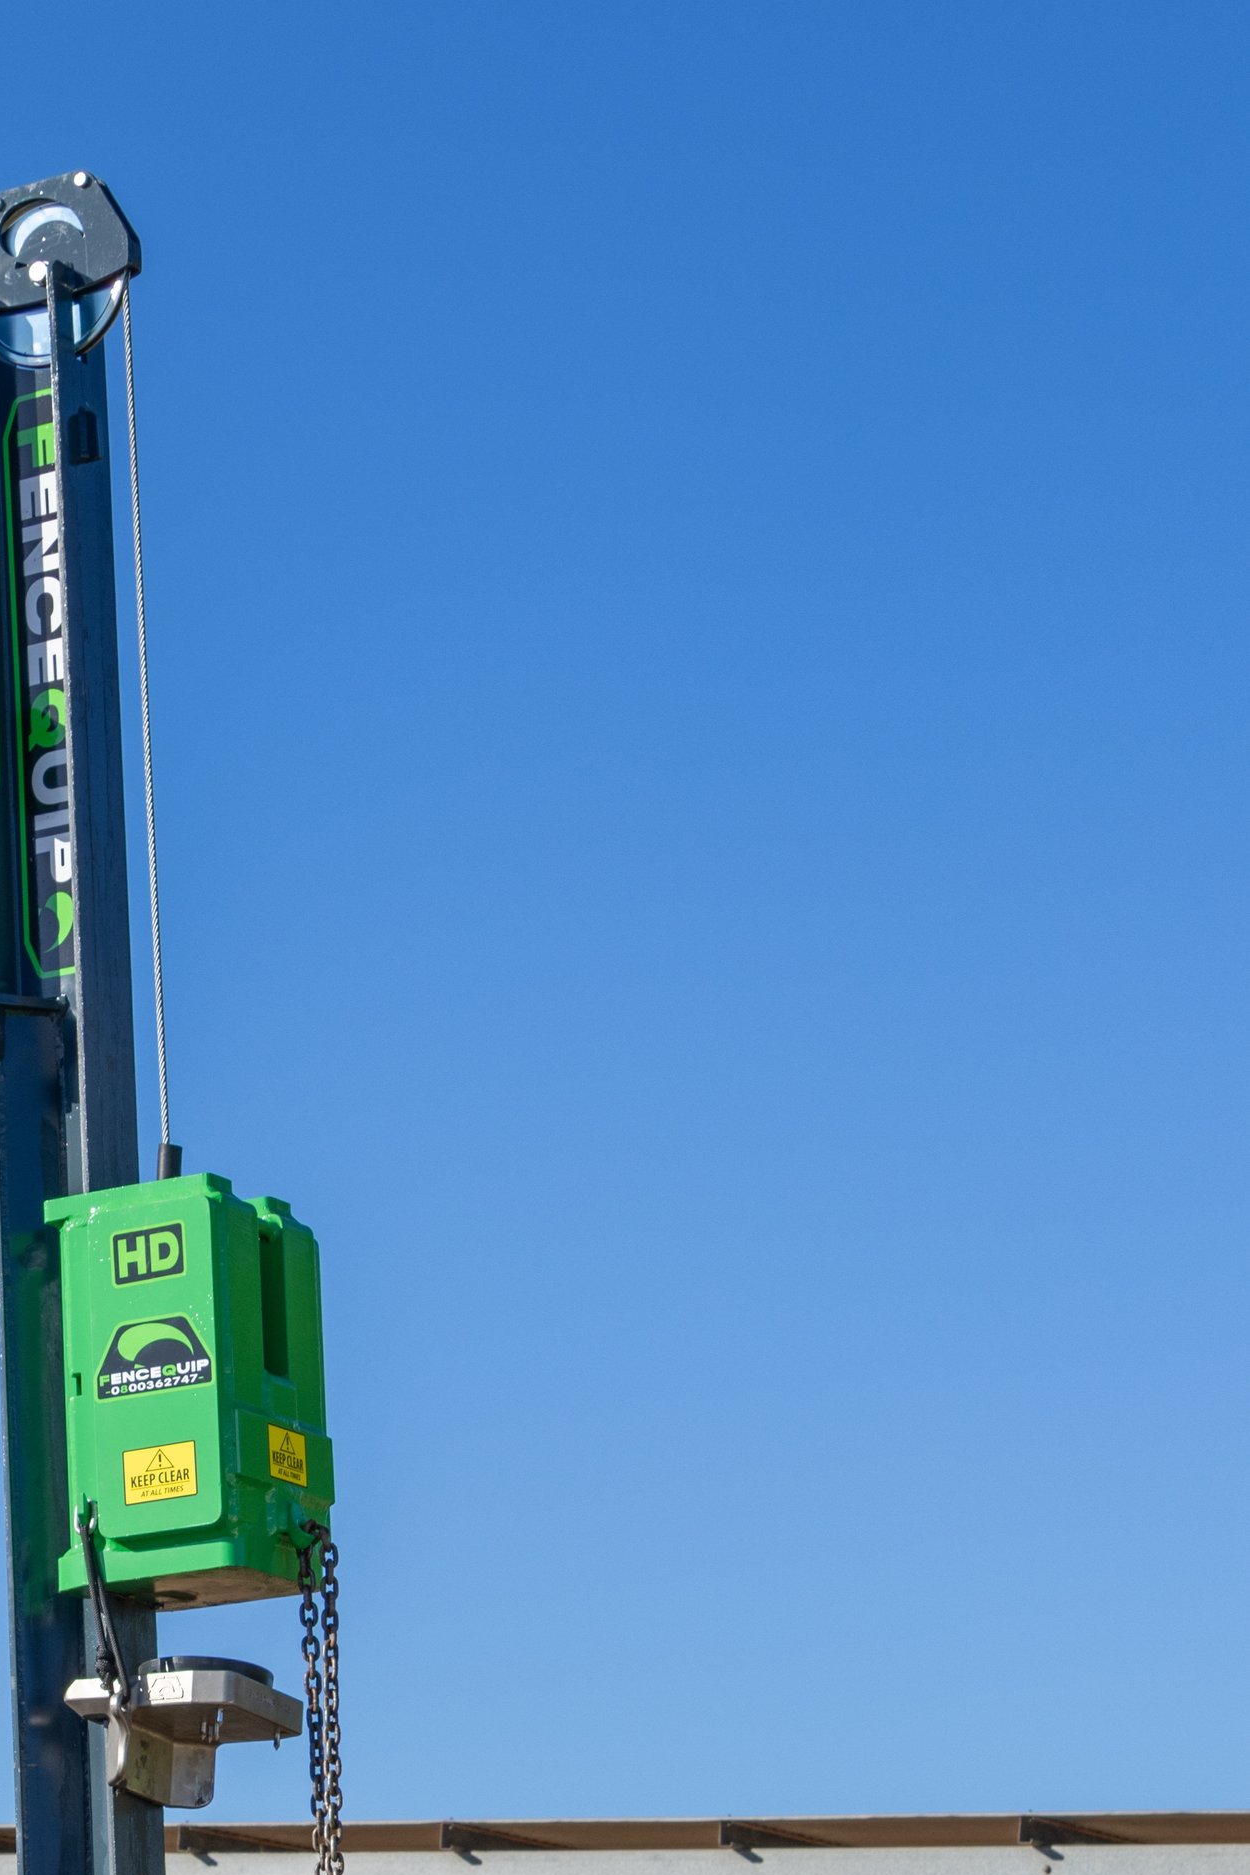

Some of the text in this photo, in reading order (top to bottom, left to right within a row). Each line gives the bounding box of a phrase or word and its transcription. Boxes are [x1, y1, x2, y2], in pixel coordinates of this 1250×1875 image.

[17, 421, 73, 883] FENCEQUIP
[117, 1231, 180, 1278] HD
[99, 1358, 210, 1387] FENCEQUIP
[272, 1450, 304, 1471] KEEP CLEAR
[130, 1468, 190, 1488] KEEP CLEAR
[141, 1485, 184, 1498] AT ALL TIMES
